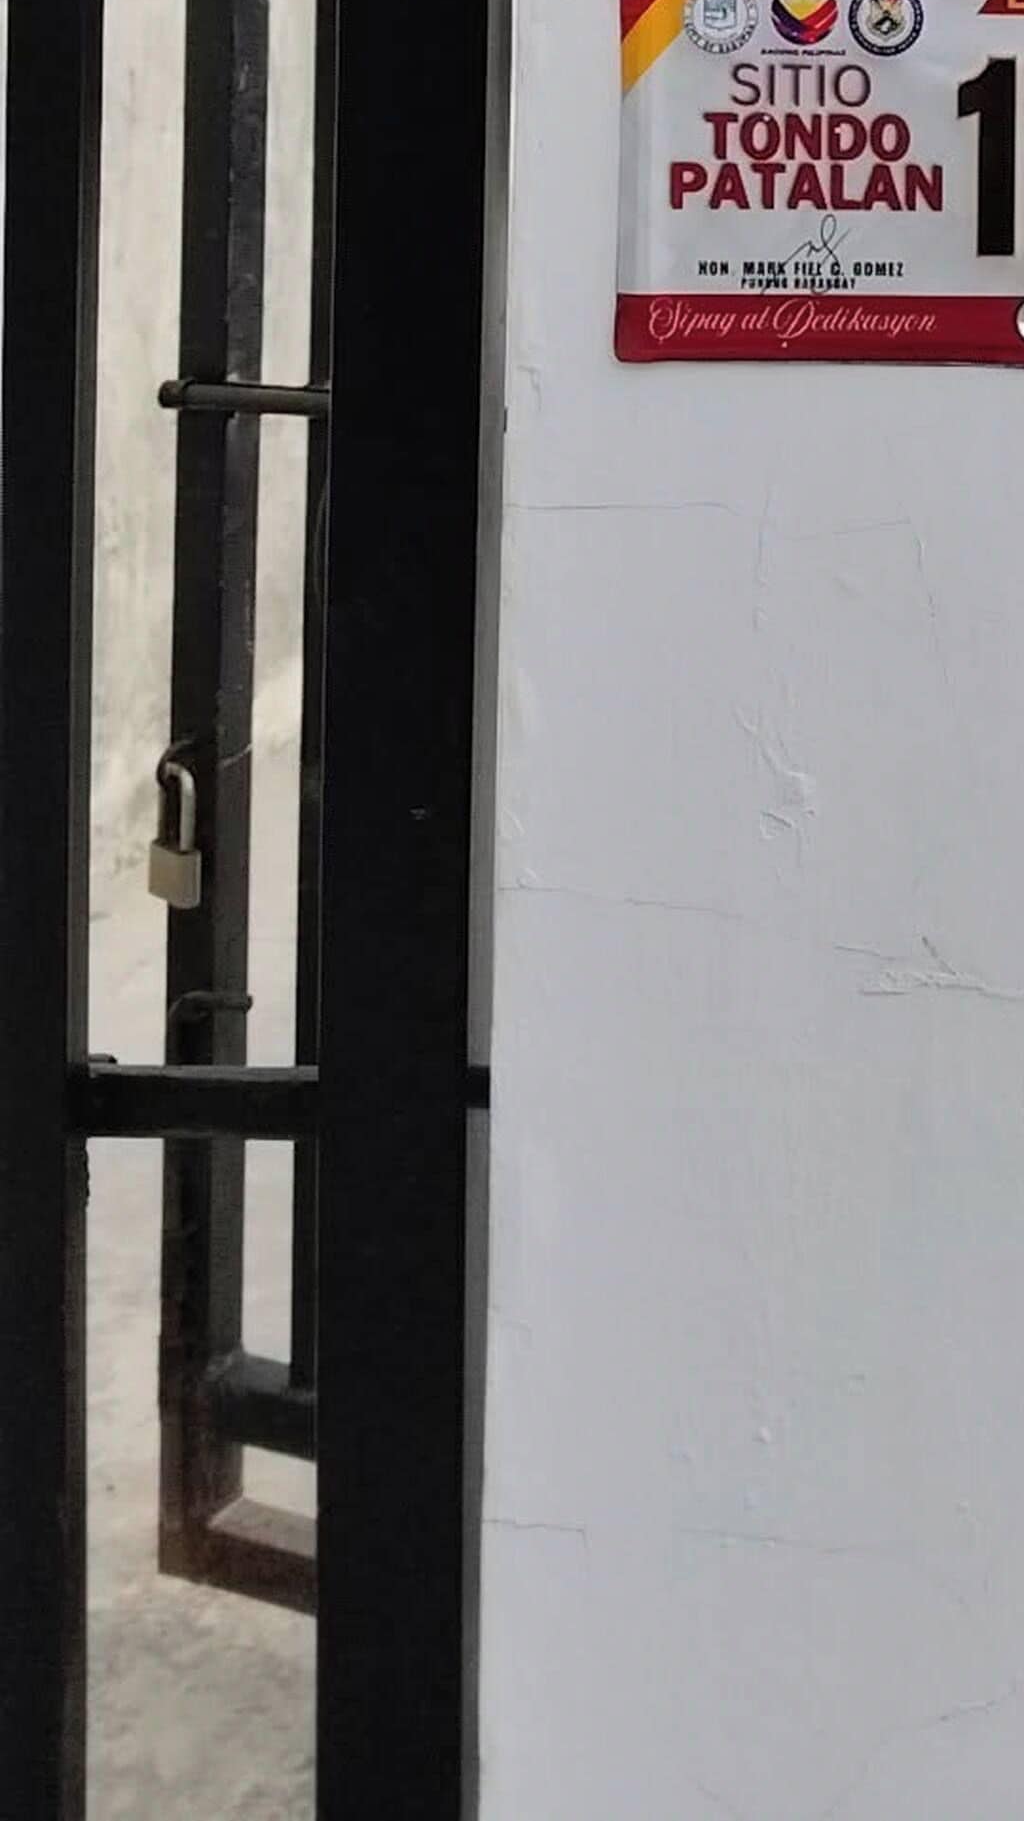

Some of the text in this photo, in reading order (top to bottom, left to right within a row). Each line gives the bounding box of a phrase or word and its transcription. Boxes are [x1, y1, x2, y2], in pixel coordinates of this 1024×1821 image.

[730, 62, 872, 108] SITIO
[703, 112, 911, 162] TONDO
[669, 161, 944, 211] PATALAN
[852, 260, 905, 278] GOMEZ
[740, 305, 772, 331] at
[772, 297, 938, 339] Dedikasyon
